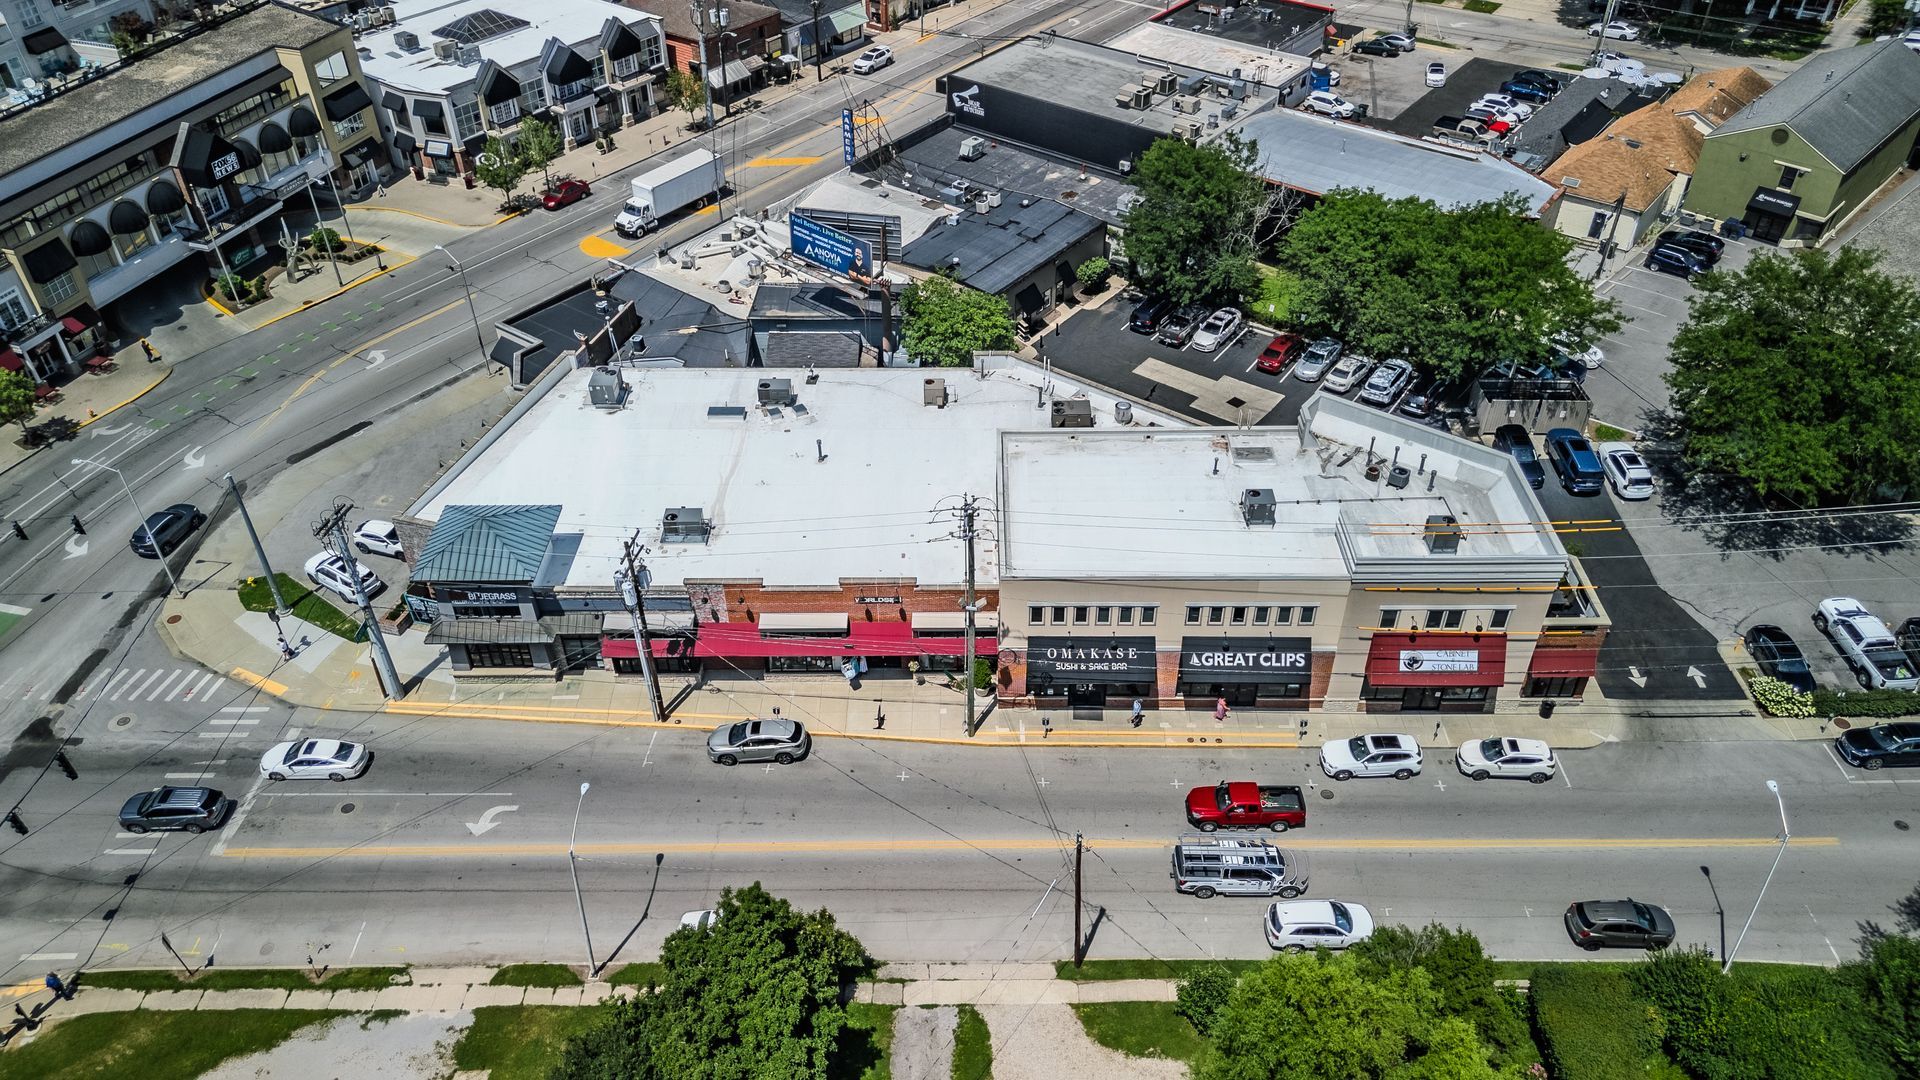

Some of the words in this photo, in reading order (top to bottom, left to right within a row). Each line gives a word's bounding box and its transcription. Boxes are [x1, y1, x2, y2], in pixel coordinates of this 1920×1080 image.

[212, 157, 227, 171] FOX
[215, 161, 239, 178] NEWS
[791, 215, 802, 224] Feel
[822, 228, 834, 238] Live
[814, 247, 842, 264] ANOVIA
[1047, 647, 1138, 659] OMAKASE
[1201, 652, 1257, 667] GREAT
[1259, 652, 1306, 667] CLIPS
[1055, 662, 1078, 671] SUSHI
[1080, 662, 1087, 671] &
[1088, 662, 1110, 671] SAKE
[1111, 662, 1128, 671] BAR
